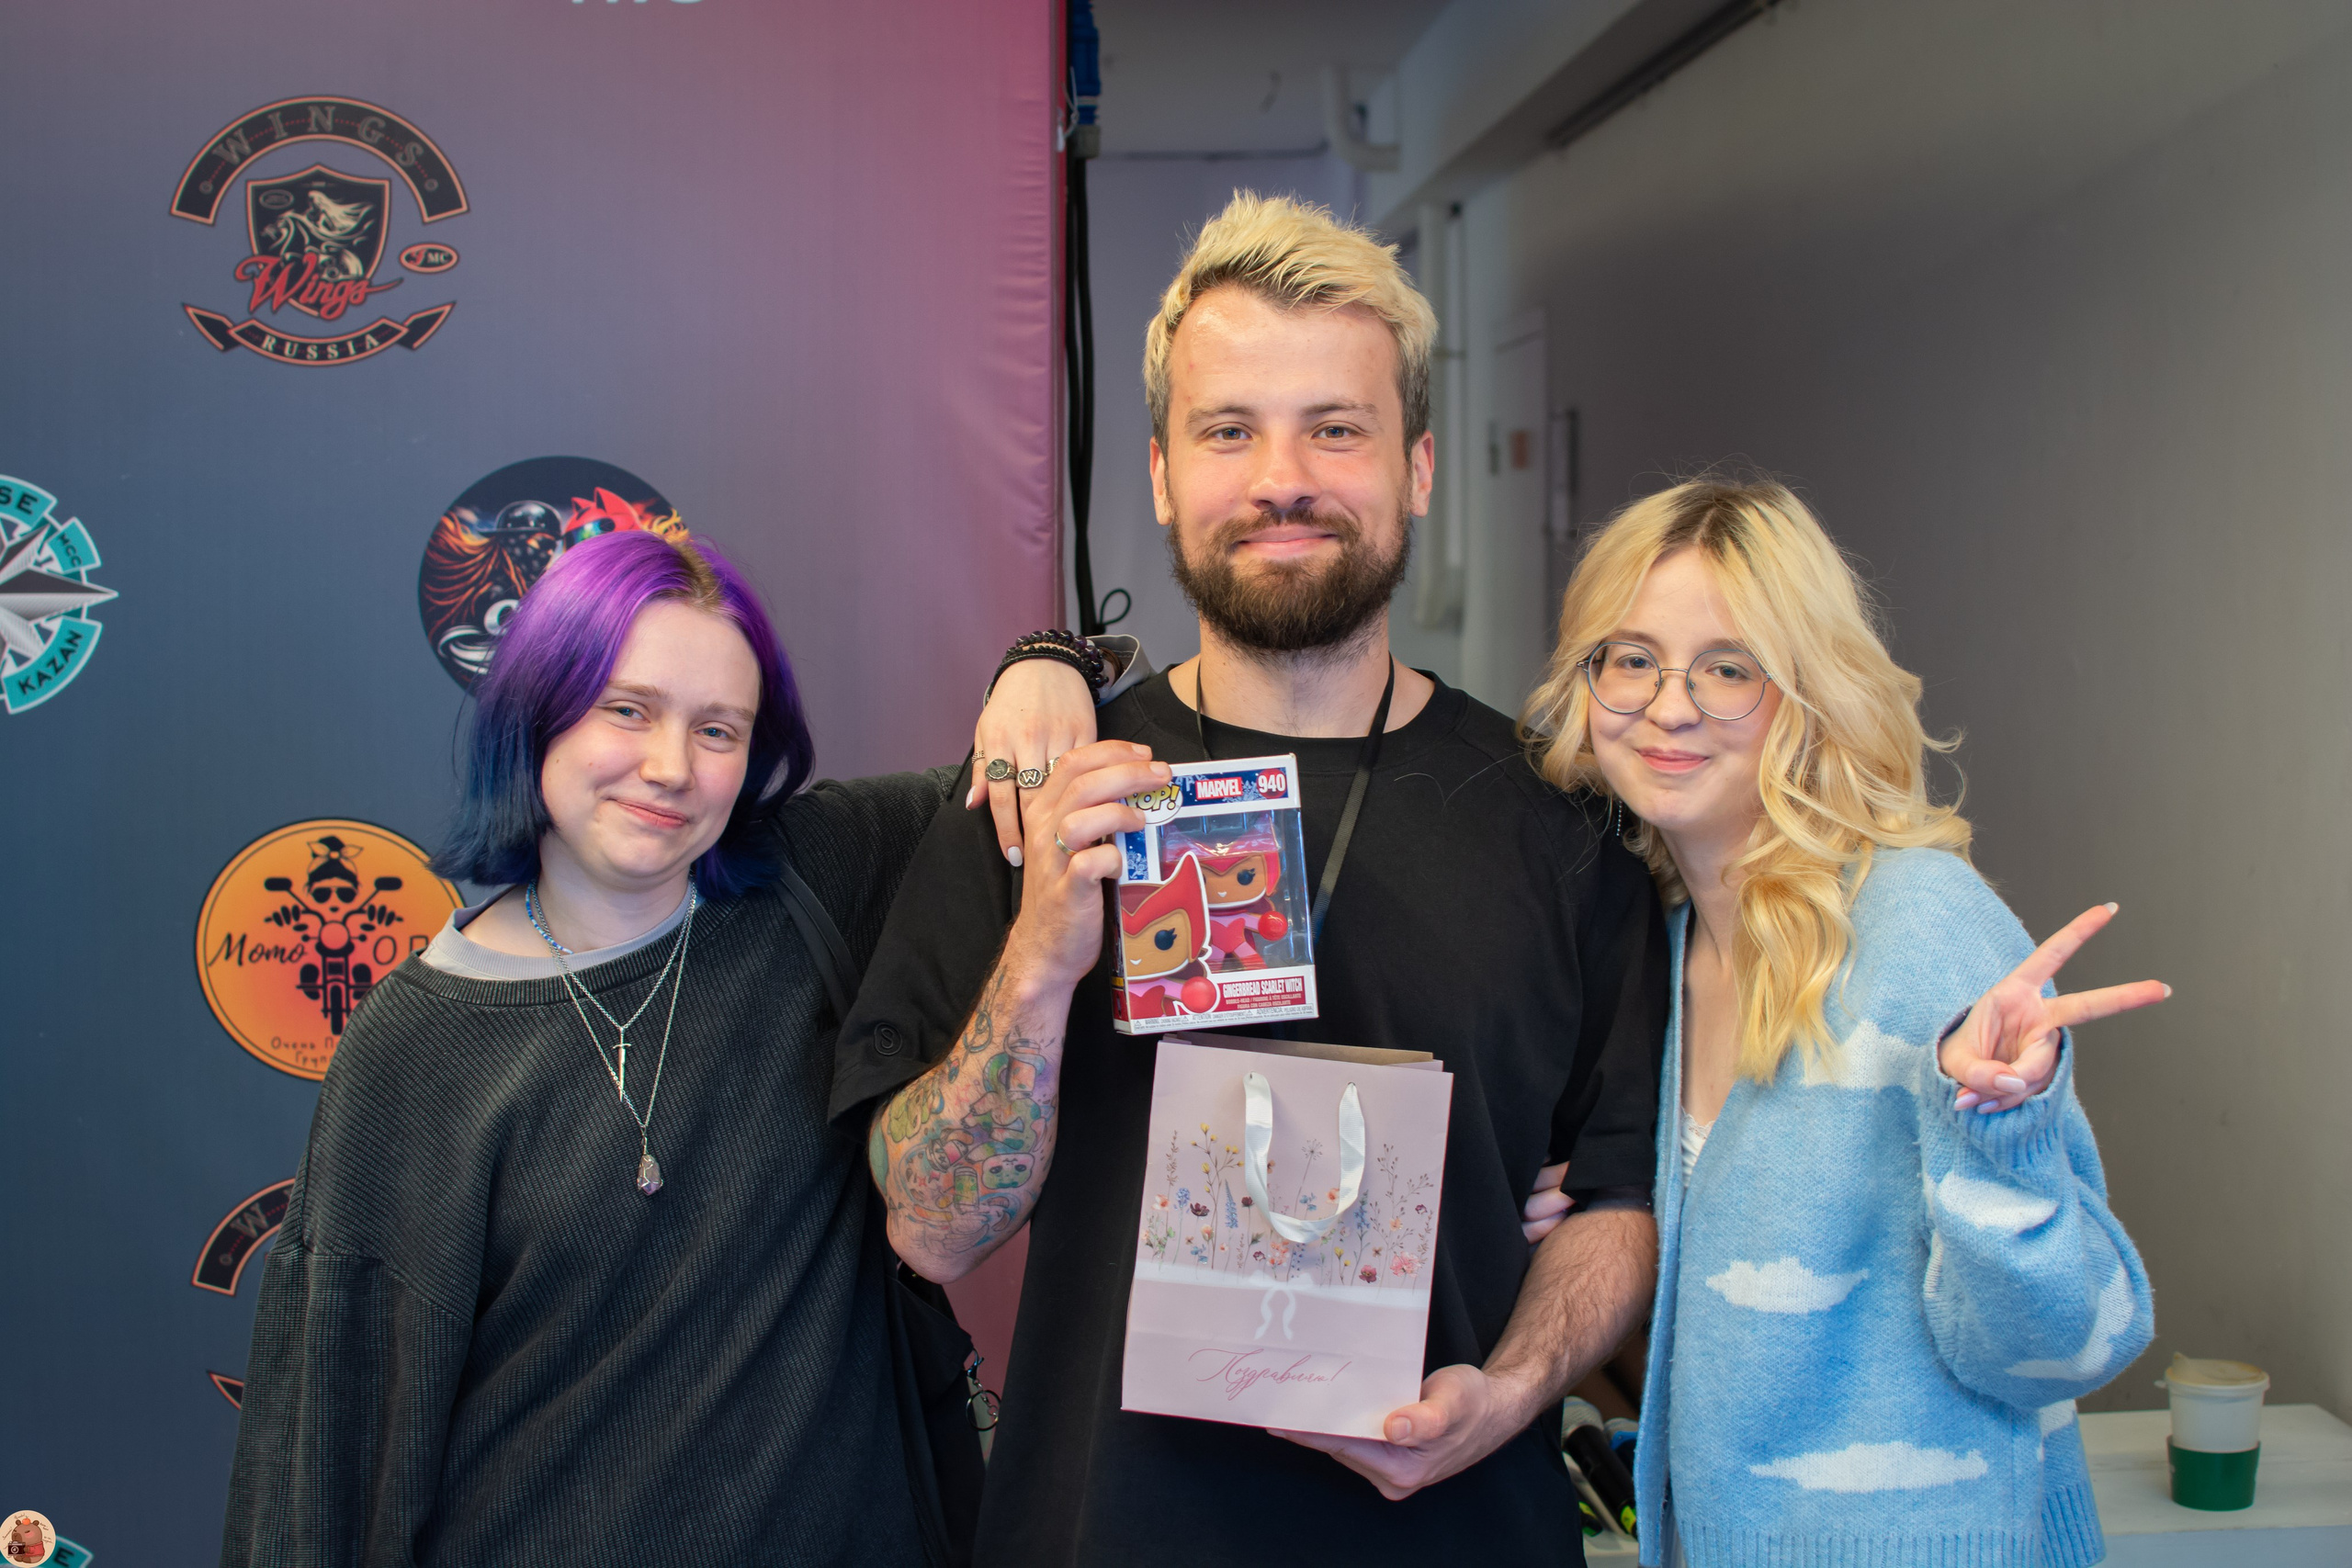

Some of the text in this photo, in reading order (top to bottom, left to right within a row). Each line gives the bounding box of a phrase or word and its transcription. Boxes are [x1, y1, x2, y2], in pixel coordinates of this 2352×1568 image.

[211, 105, 424, 166] WINGS
[234, 252, 404, 320] Wings
[261, 332, 380, 361] RUSSIA
[0, 486, 39, 514] SE
[17, 628, 84, 695] KAZAN
[1196, 778, 1241, 798] MARVEL
[1258, 773, 1286, 794] 940
[1222, 977, 1303, 998] GINGERBREAD SCARLET WITCH
[270, 1035, 316, 1050] Очень
[295, 1050, 331, 1068] Груп
